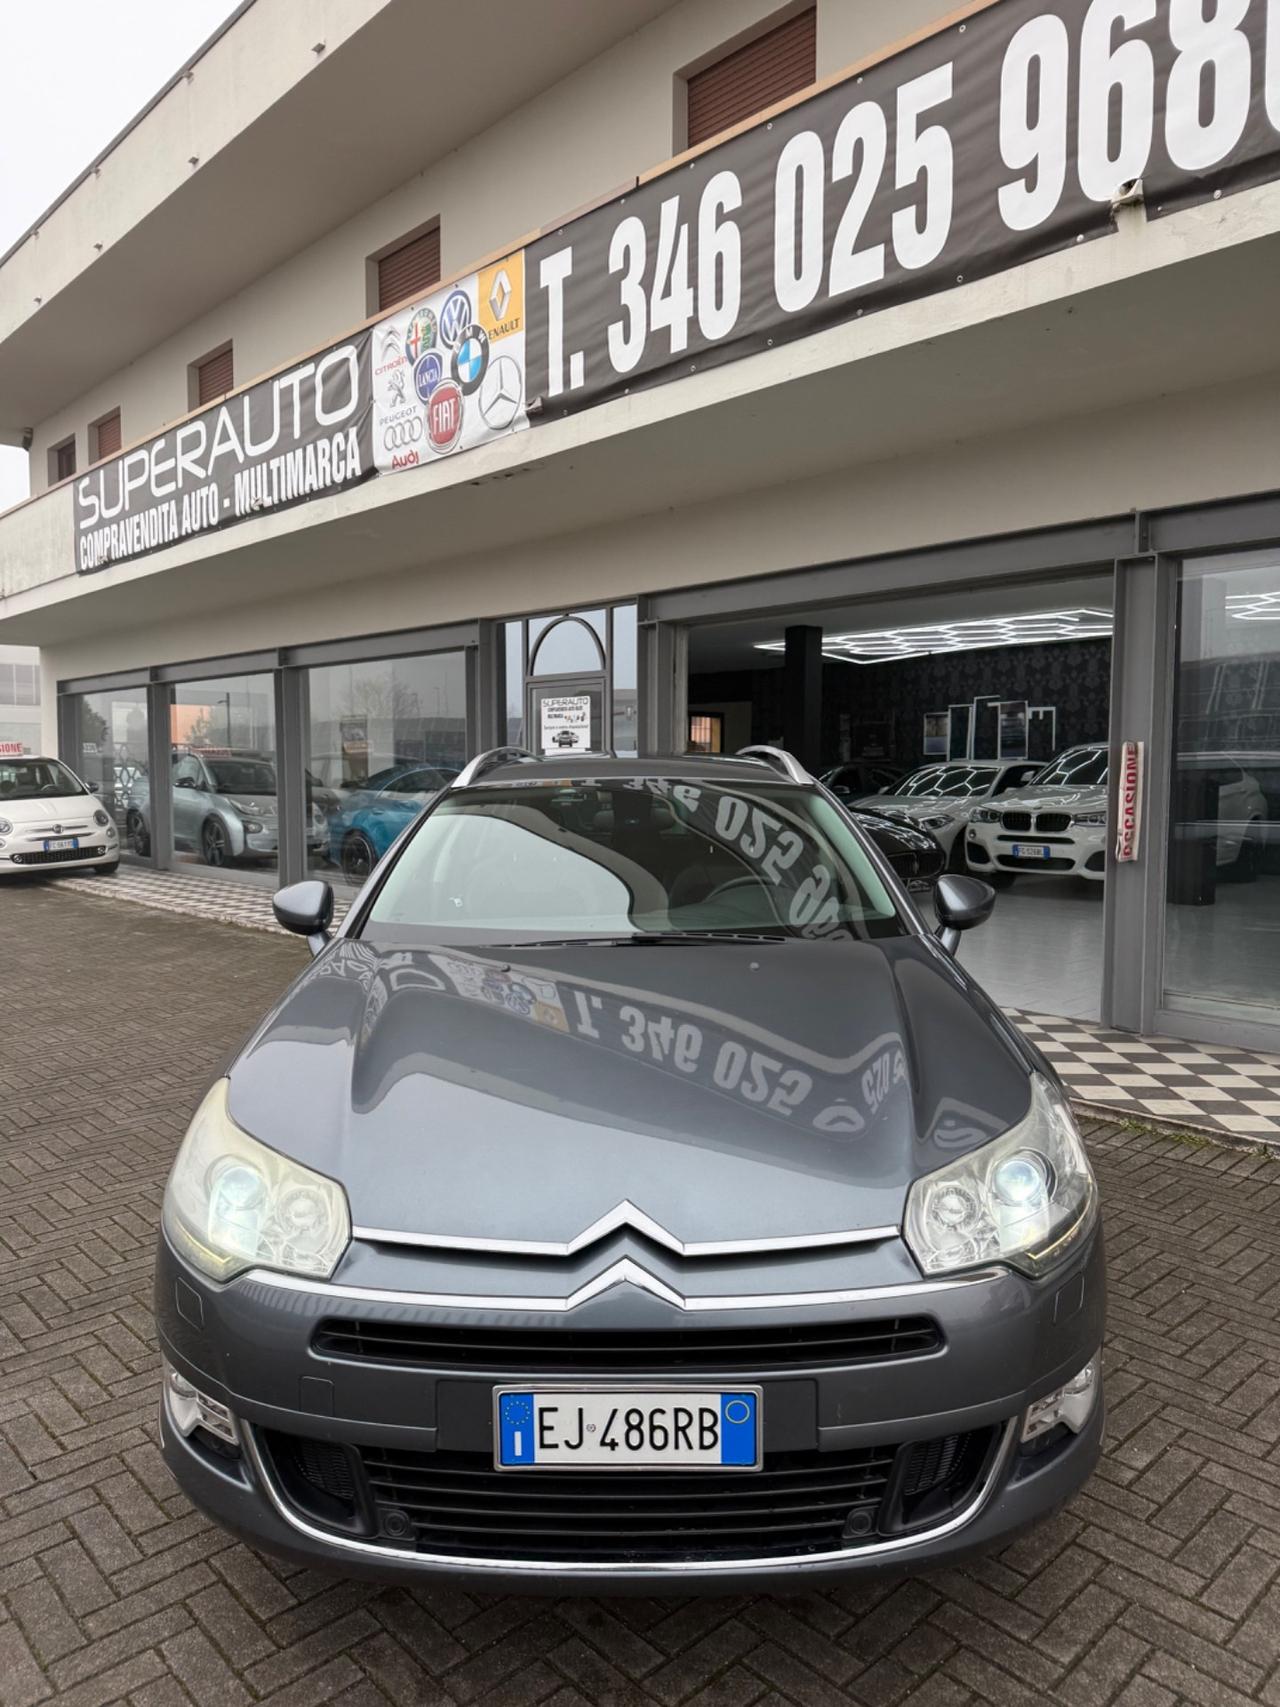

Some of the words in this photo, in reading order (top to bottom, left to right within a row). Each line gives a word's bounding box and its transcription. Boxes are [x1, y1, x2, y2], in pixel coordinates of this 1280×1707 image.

[539, 247, 585, 397] T.
[607, 171, 743, 373] 346
[774, 61, 954, 312] 025
[997, 0, 1280, 231] 968
[487, 317, 521, 340] ENAULT
[418, 368, 439, 387] LANCIA
[379, 405, 417, 426] PEUGEOT
[432, 398, 457, 434] FIAT
[78, 345, 359, 529] SUPERAUTO
[391, 449, 420, 469] Audi
[79, 499, 179, 571] COMPRAVENDITA
[181, 482, 220, 536] AUTO
[233, 426, 362, 518] MULTIMARCA
